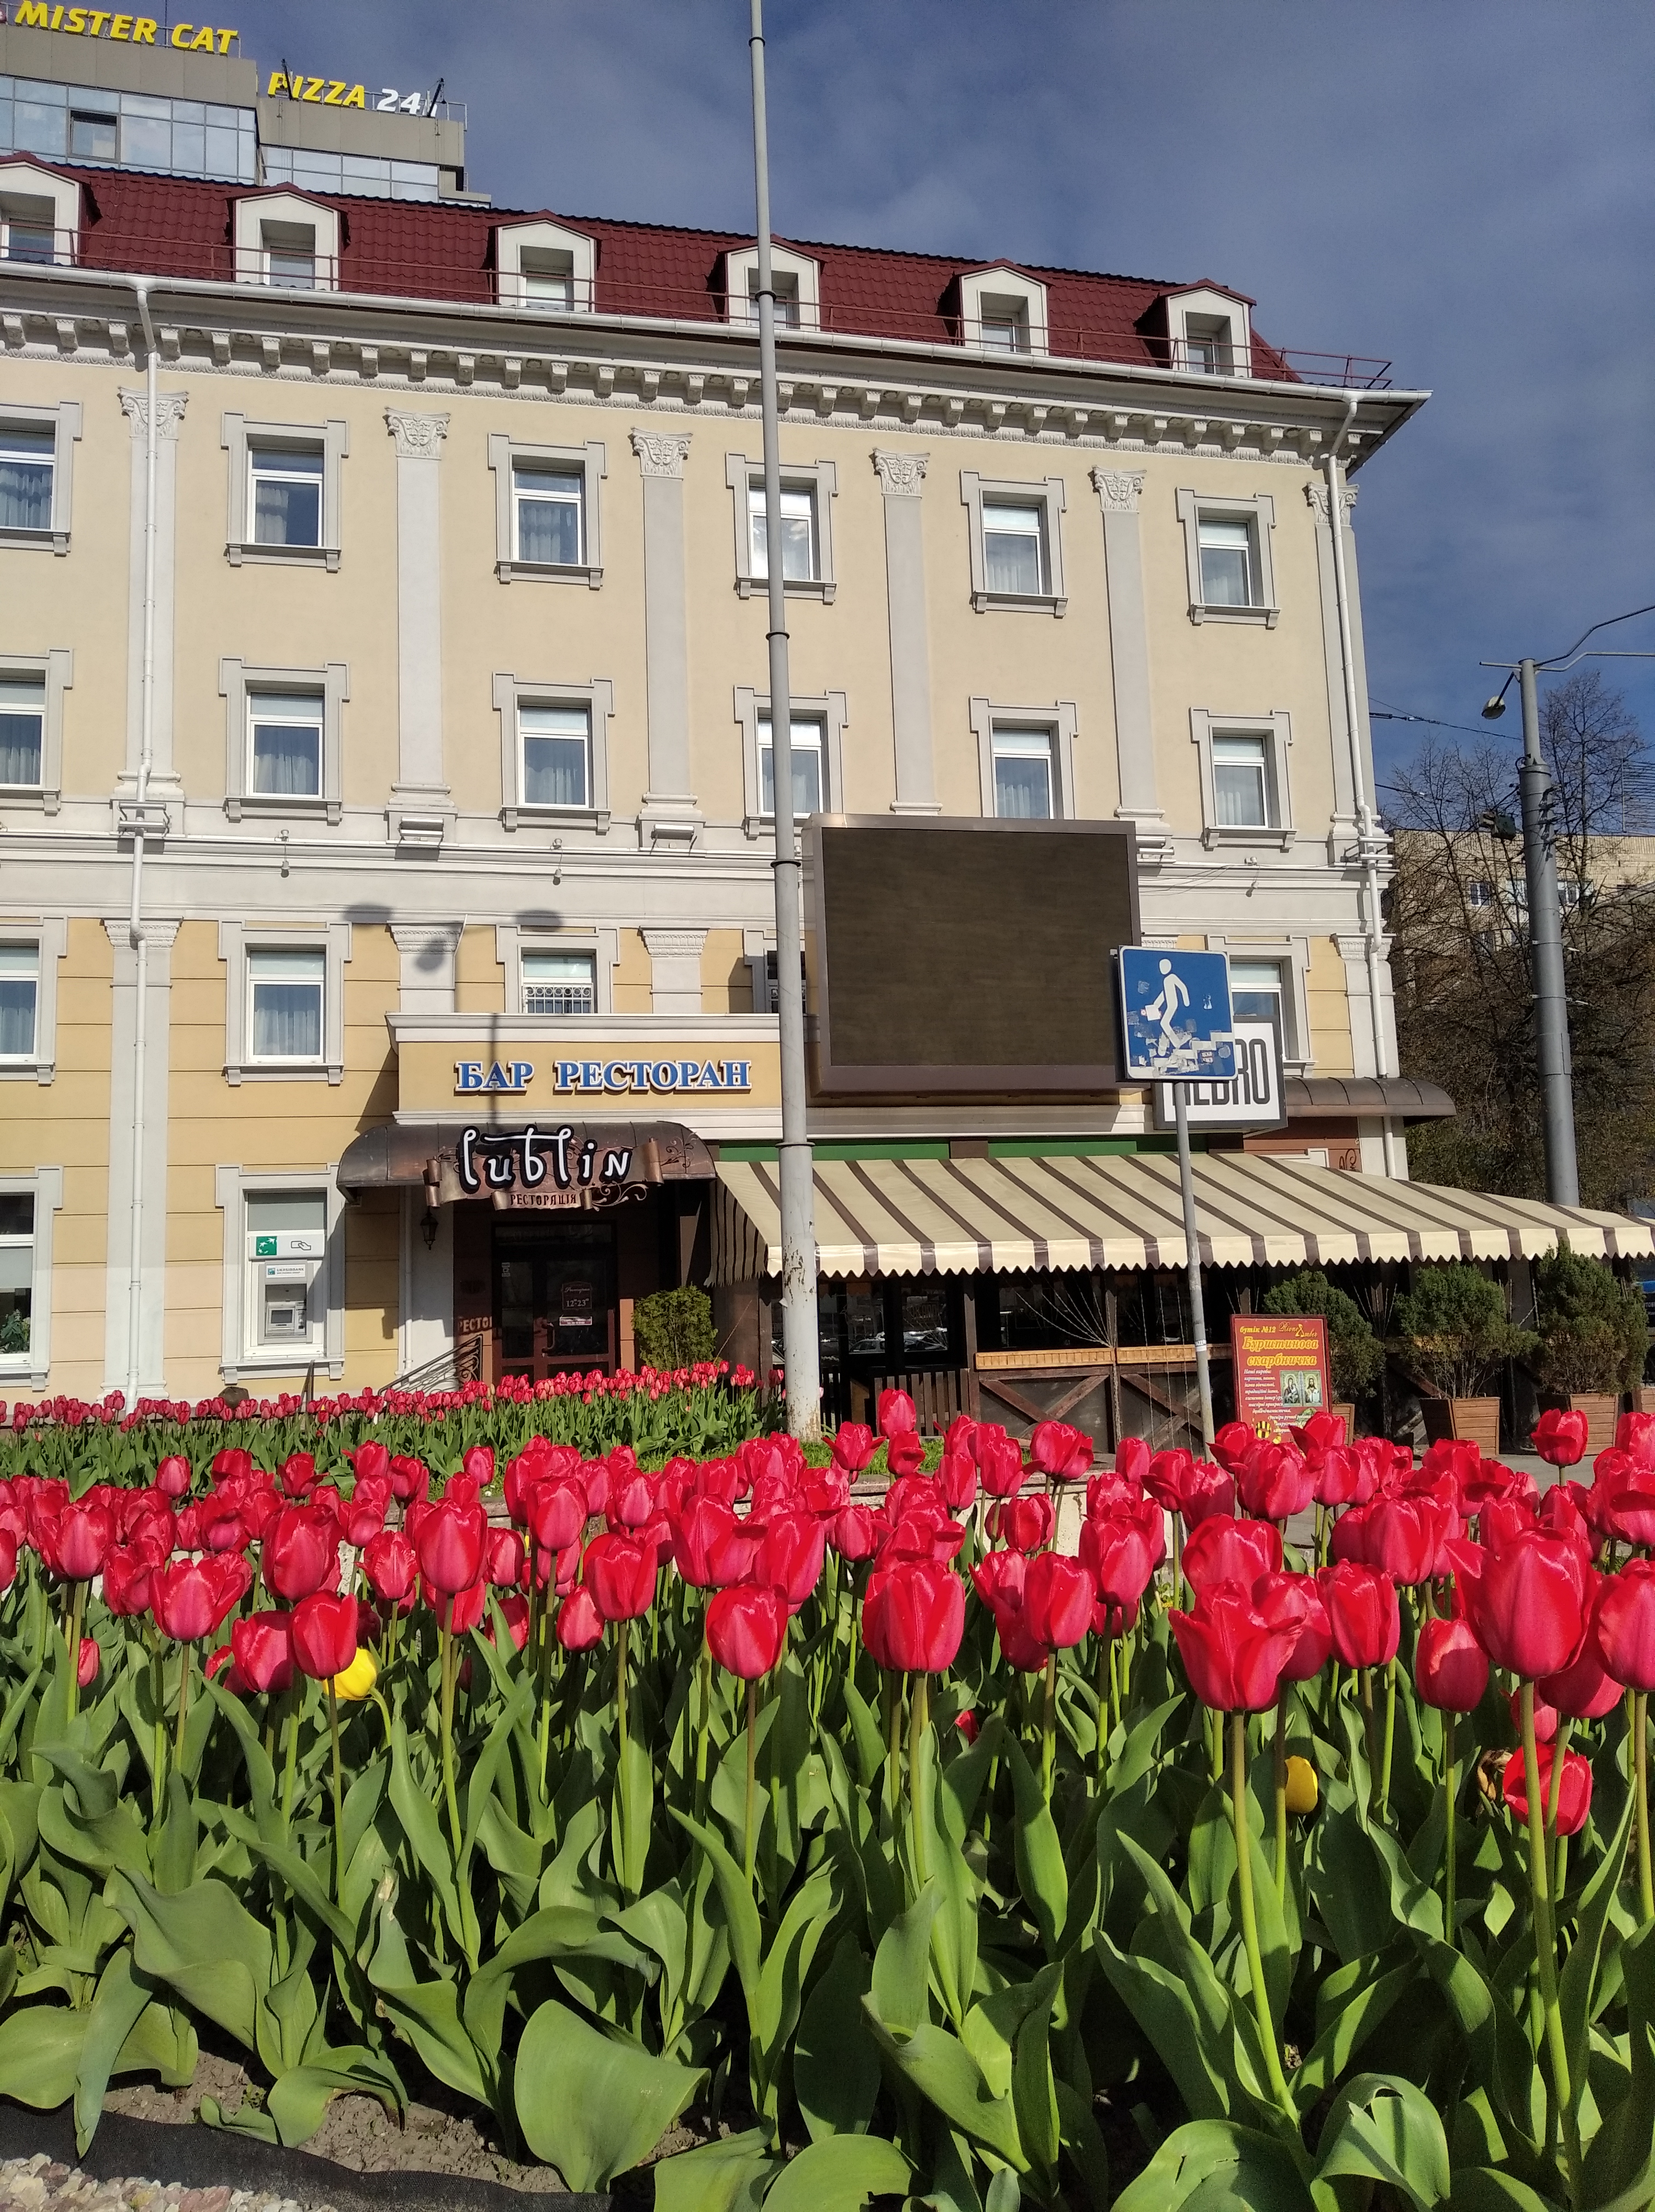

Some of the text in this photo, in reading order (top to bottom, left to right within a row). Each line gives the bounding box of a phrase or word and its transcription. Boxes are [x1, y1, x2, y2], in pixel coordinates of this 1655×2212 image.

[14, 0, 238, 54] MISTER CAT
[267, 71, 365, 109] PIZZA
[455, 1060, 752, 1092] БАР РЕСТОРАН
[1242, 1336, 1319, 1352] Бурштинова
[1247, 1352, 1317, 1368] скарбничка
